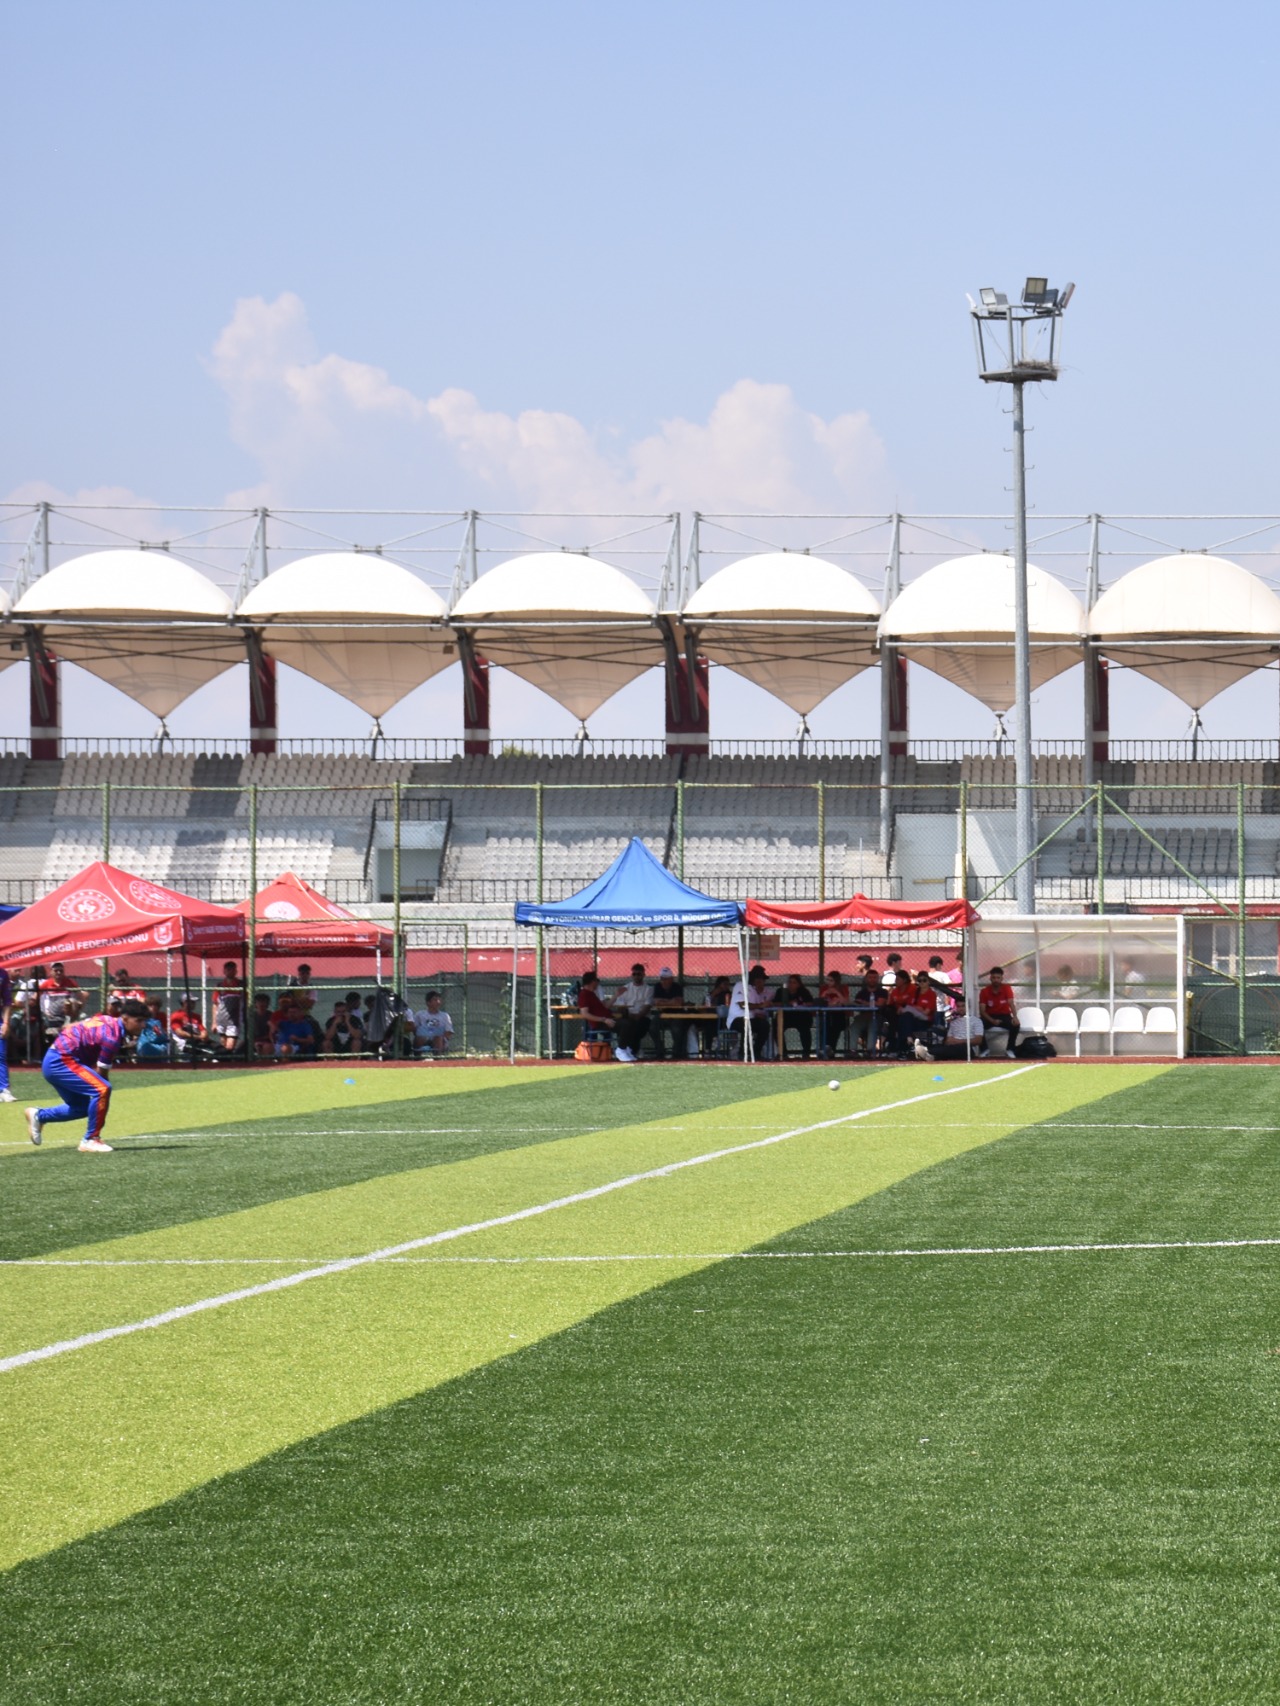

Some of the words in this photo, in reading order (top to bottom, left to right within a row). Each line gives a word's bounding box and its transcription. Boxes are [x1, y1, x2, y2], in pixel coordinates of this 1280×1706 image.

[611, 914, 643, 923] GENÇLİK
[653, 914, 673, 922] SPOR
[842, 916, 872, 926] GENÇLİK
[44, 941, 75, 955] RAGBİ
[77, 933, 149, 950] FEDERASYONU
